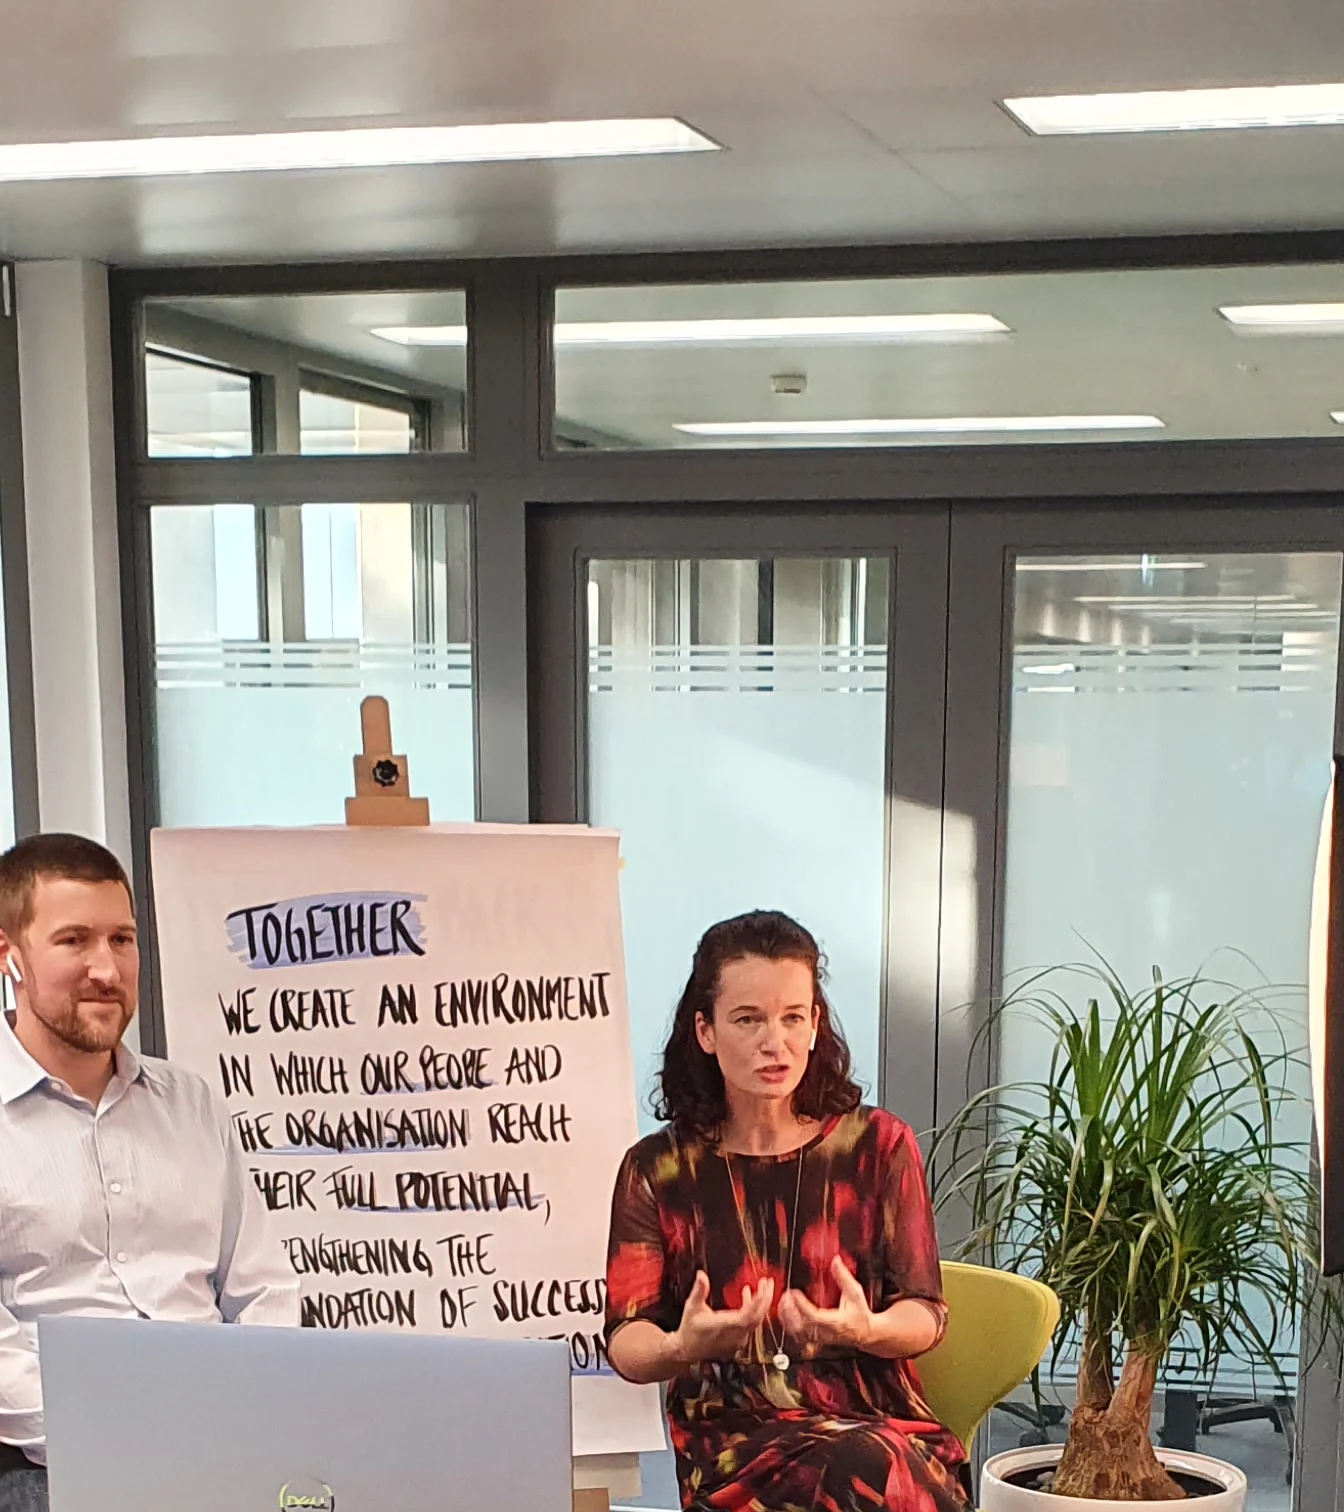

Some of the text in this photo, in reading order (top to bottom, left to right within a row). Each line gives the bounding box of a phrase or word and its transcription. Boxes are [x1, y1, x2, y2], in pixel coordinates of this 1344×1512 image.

[226, 900, 426, 965] TOGETHER
[218, 971, 612, 1037] WE CREATE AN ENVIRONMENT
[219, 1053, 255, 1098] IN
[270, 1050, 350, 1097] WHICH
[360, 1050, 416, 1094] OUR
[504, 1044, 563, 1086] AND
[285, 1107, 469, 1154] ORGANISATION
[487, 1102, 573, 1145] REACH
[323, 1164, 388, 1211] FULL
[281, 1232, 497, 1279] ENGTHENING THE
[301, 1288, 417, 1330] NDATION
[440, 1285, 479, 1329] OF
